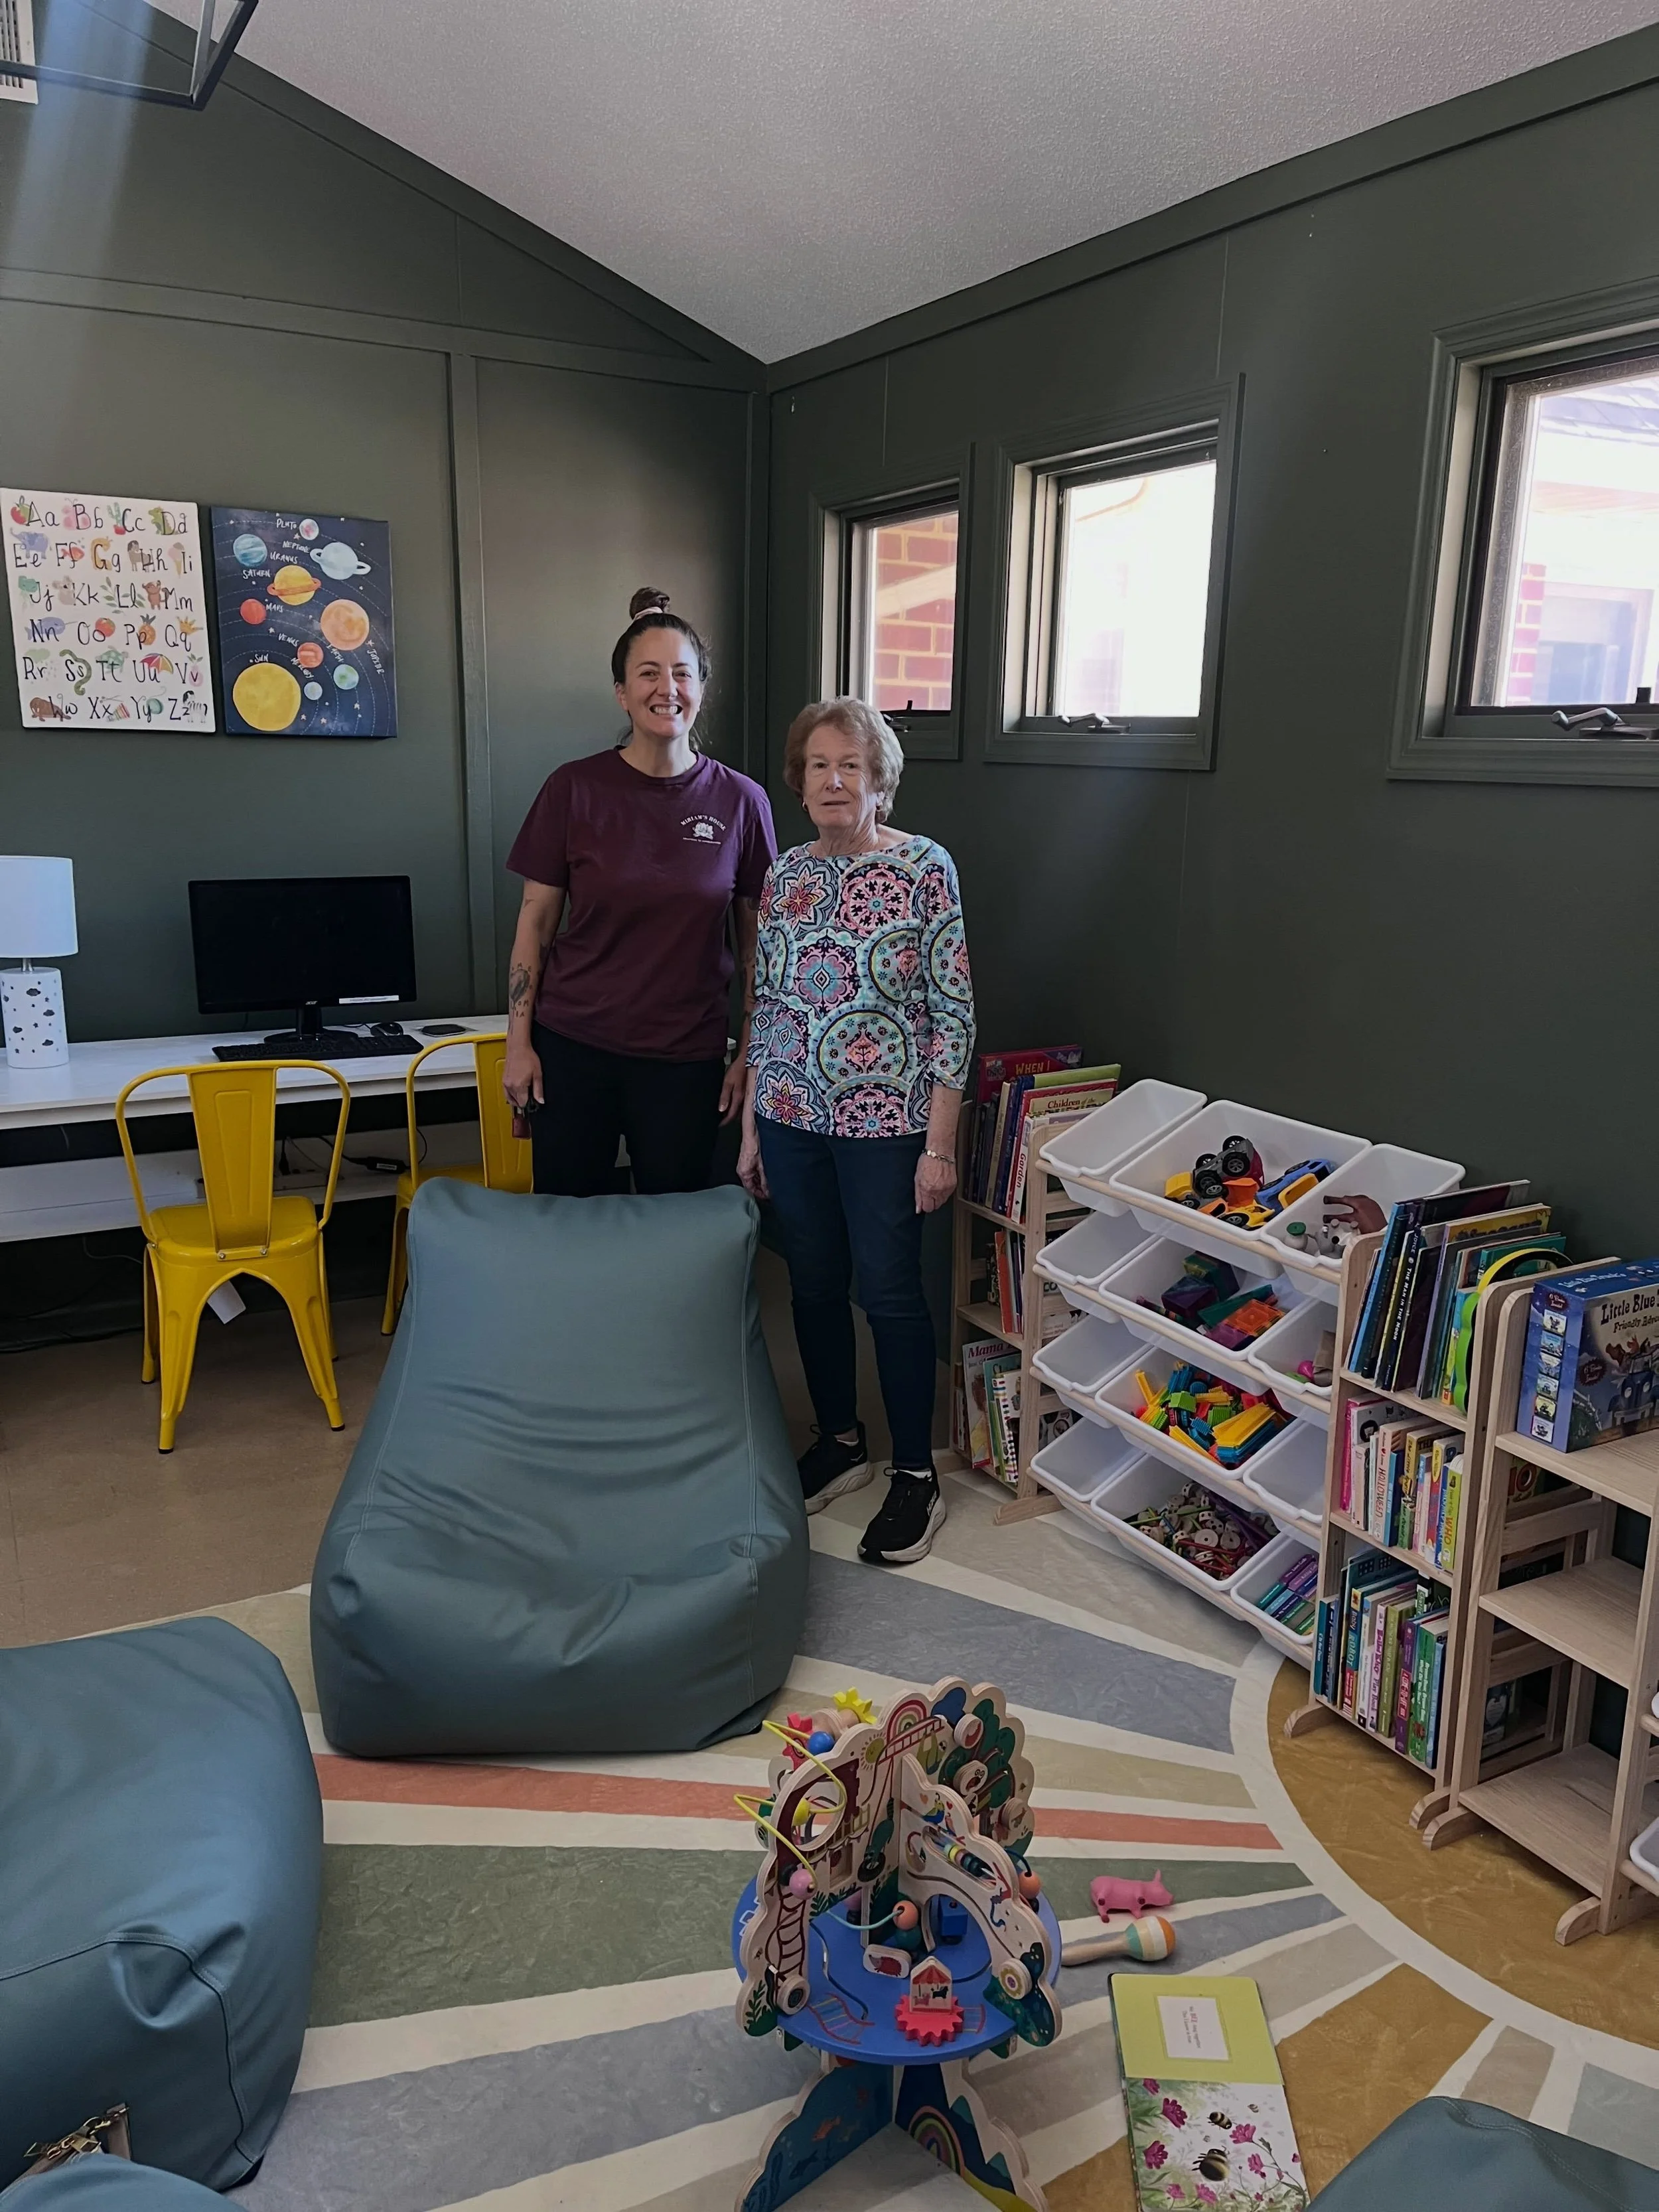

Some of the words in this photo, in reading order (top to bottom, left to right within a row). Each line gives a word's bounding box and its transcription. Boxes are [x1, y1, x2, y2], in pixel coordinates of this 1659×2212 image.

[276, 518, 297, 530] PLUTO
[242, 569, 271, 579] SATURN
[254, 653, 269, 663] SUN
[680, 815, 708, 826] MIRIAM'S
[709, 816, 727, 831] HOUSE
[1015, 1063, 1045, 1075] WHEN
[1048, 1098, 1080, 1108] Children
[1016, 1153, 1027, 1188] Garden
[1409, 1233, 1420, 1254] JOYCE
[1404, 1267, 1412, 1280] THE
[1400, 1282, 1409, 1297] MAN
[1601, 1300, 1630, 1325] Little
[1632, 1293, 1655, 1313] Blue
[1391, 1321, 1401, 1340] MOON
[1613, 1316, 1641, 1333] Friendly
[968, 1341, 1004, 1359] Mama
[1372, 1467, 1388, 1517] HALLOWEEN
[1443, 1516, 1453, 1544] WHO
[1346, 1635, 1356, 1666] ROBOT
